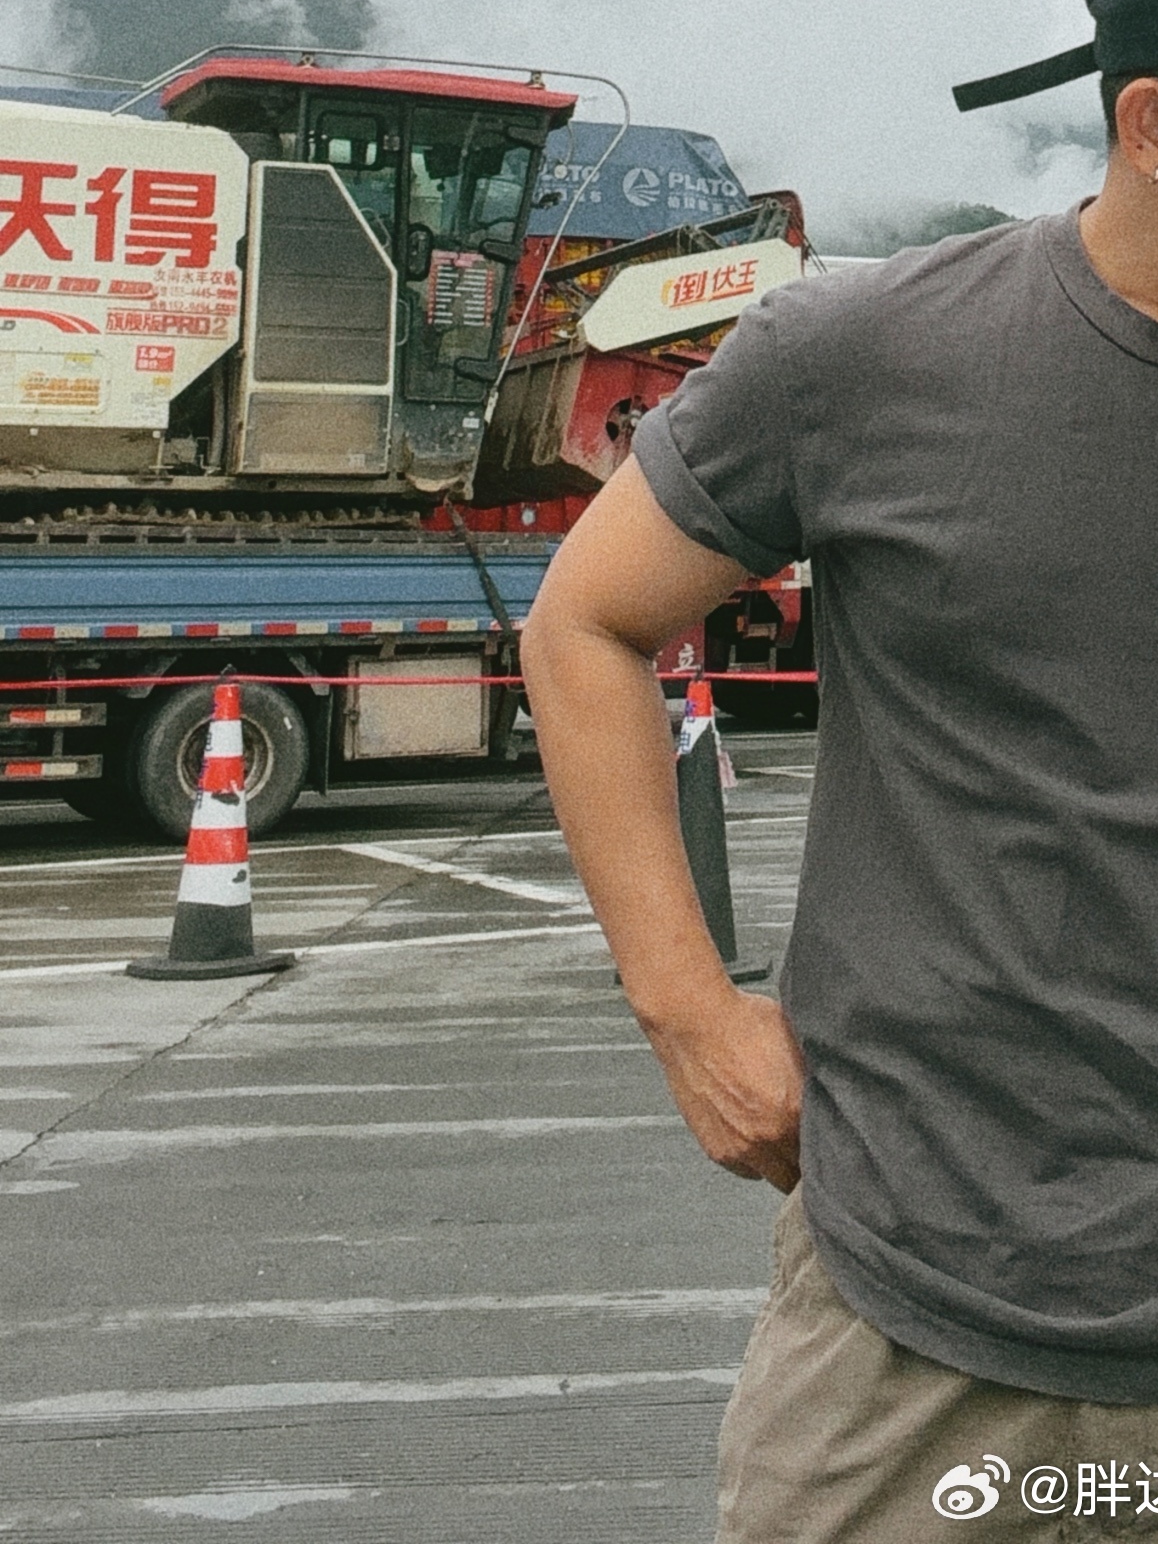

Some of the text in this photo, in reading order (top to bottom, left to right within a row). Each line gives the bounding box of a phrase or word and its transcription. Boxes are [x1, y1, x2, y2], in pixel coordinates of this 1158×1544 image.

[668, 171, 740, 197] PLATO
[672, 260, 759, 304] 倒伏王
